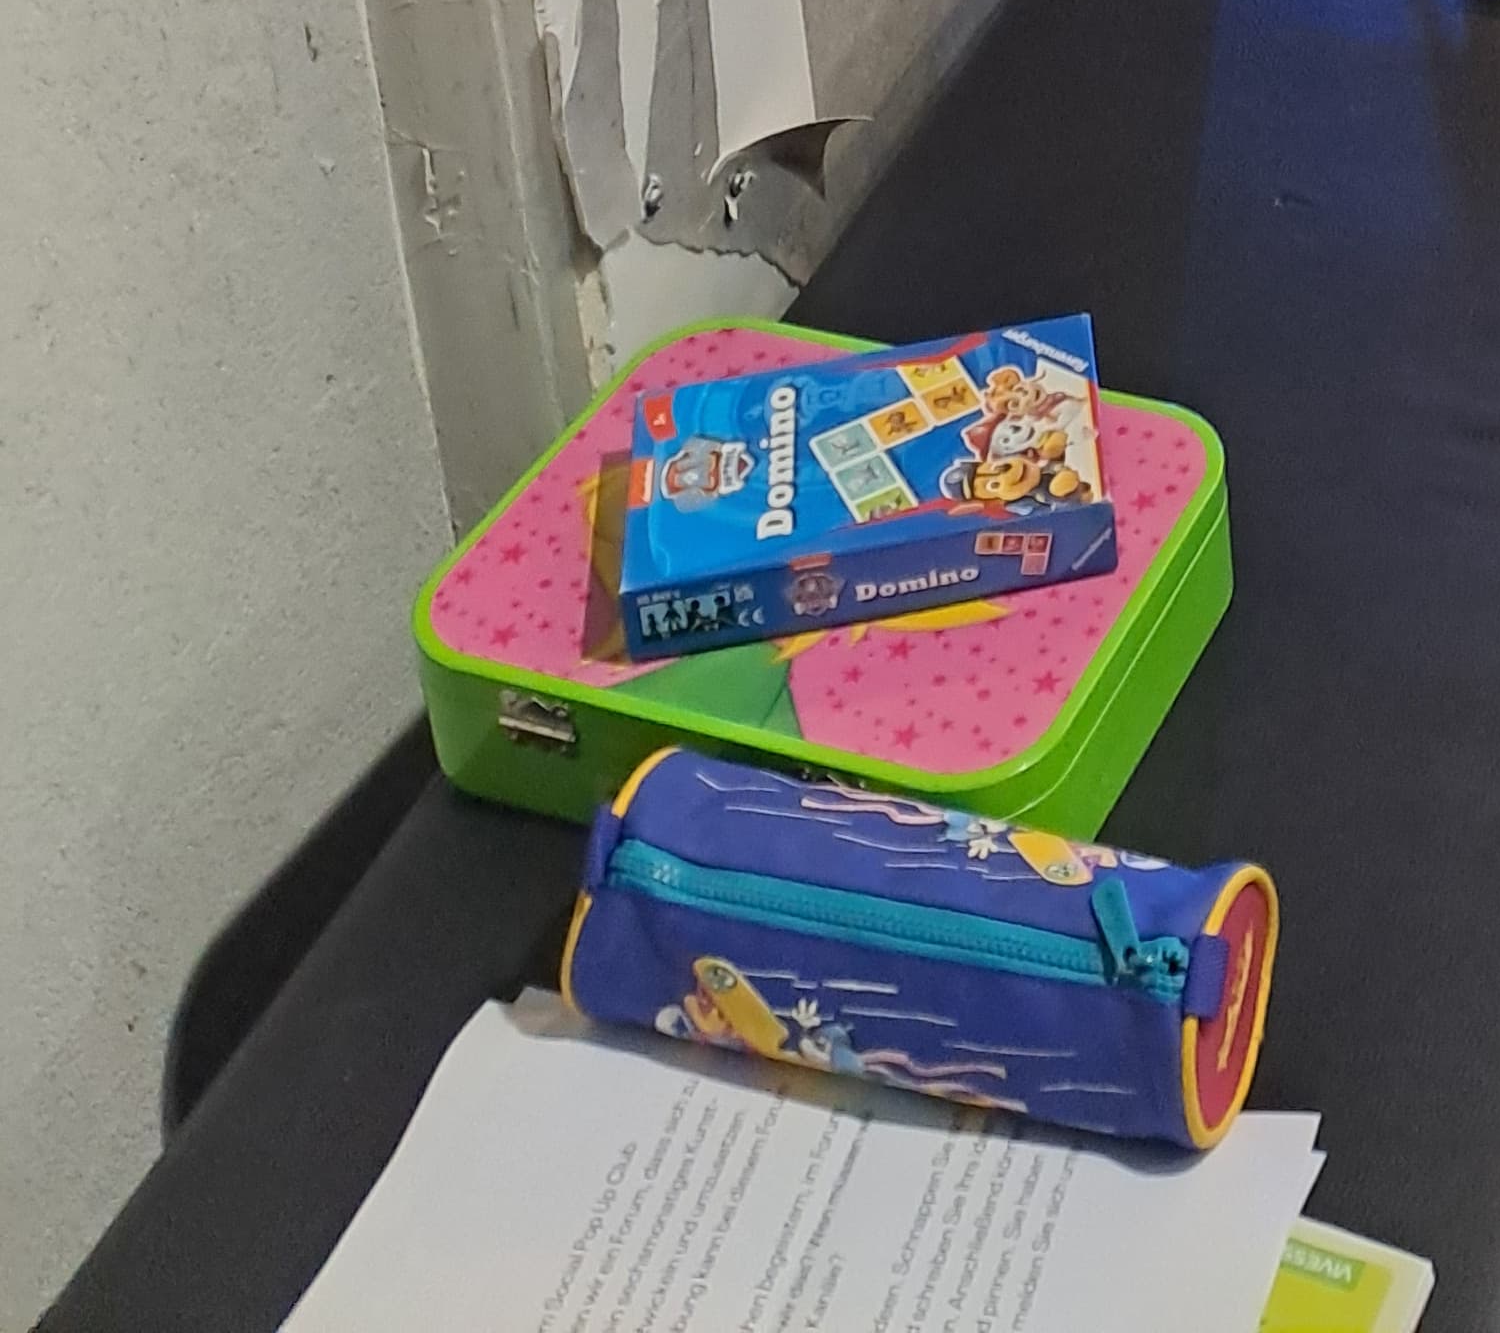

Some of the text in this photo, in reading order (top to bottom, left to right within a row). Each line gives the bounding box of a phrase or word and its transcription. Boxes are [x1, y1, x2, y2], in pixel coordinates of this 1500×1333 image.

[756, 387, 796, 540] Domino
[855, 567, 979, 601] Domino
[602, 1135, 641, 1189] Club
[590, 1183, 619, 1218] Up
[889, 1167, 947, 1278] Schnappen
[1000, 1206, 1028, 1242] Sie
[571, 1211, 607, 1257] Pop
[672, 1215, 701, 1254] und
[907, 1224, 958, 1323] schreiben
[940, 1191, 968, 1227] Sie
[946, 1178, 1005, 1311] Anschließend
[1029, 1218, 1056, 1254] Sie
[542, 1250, 586, 1315] Social
